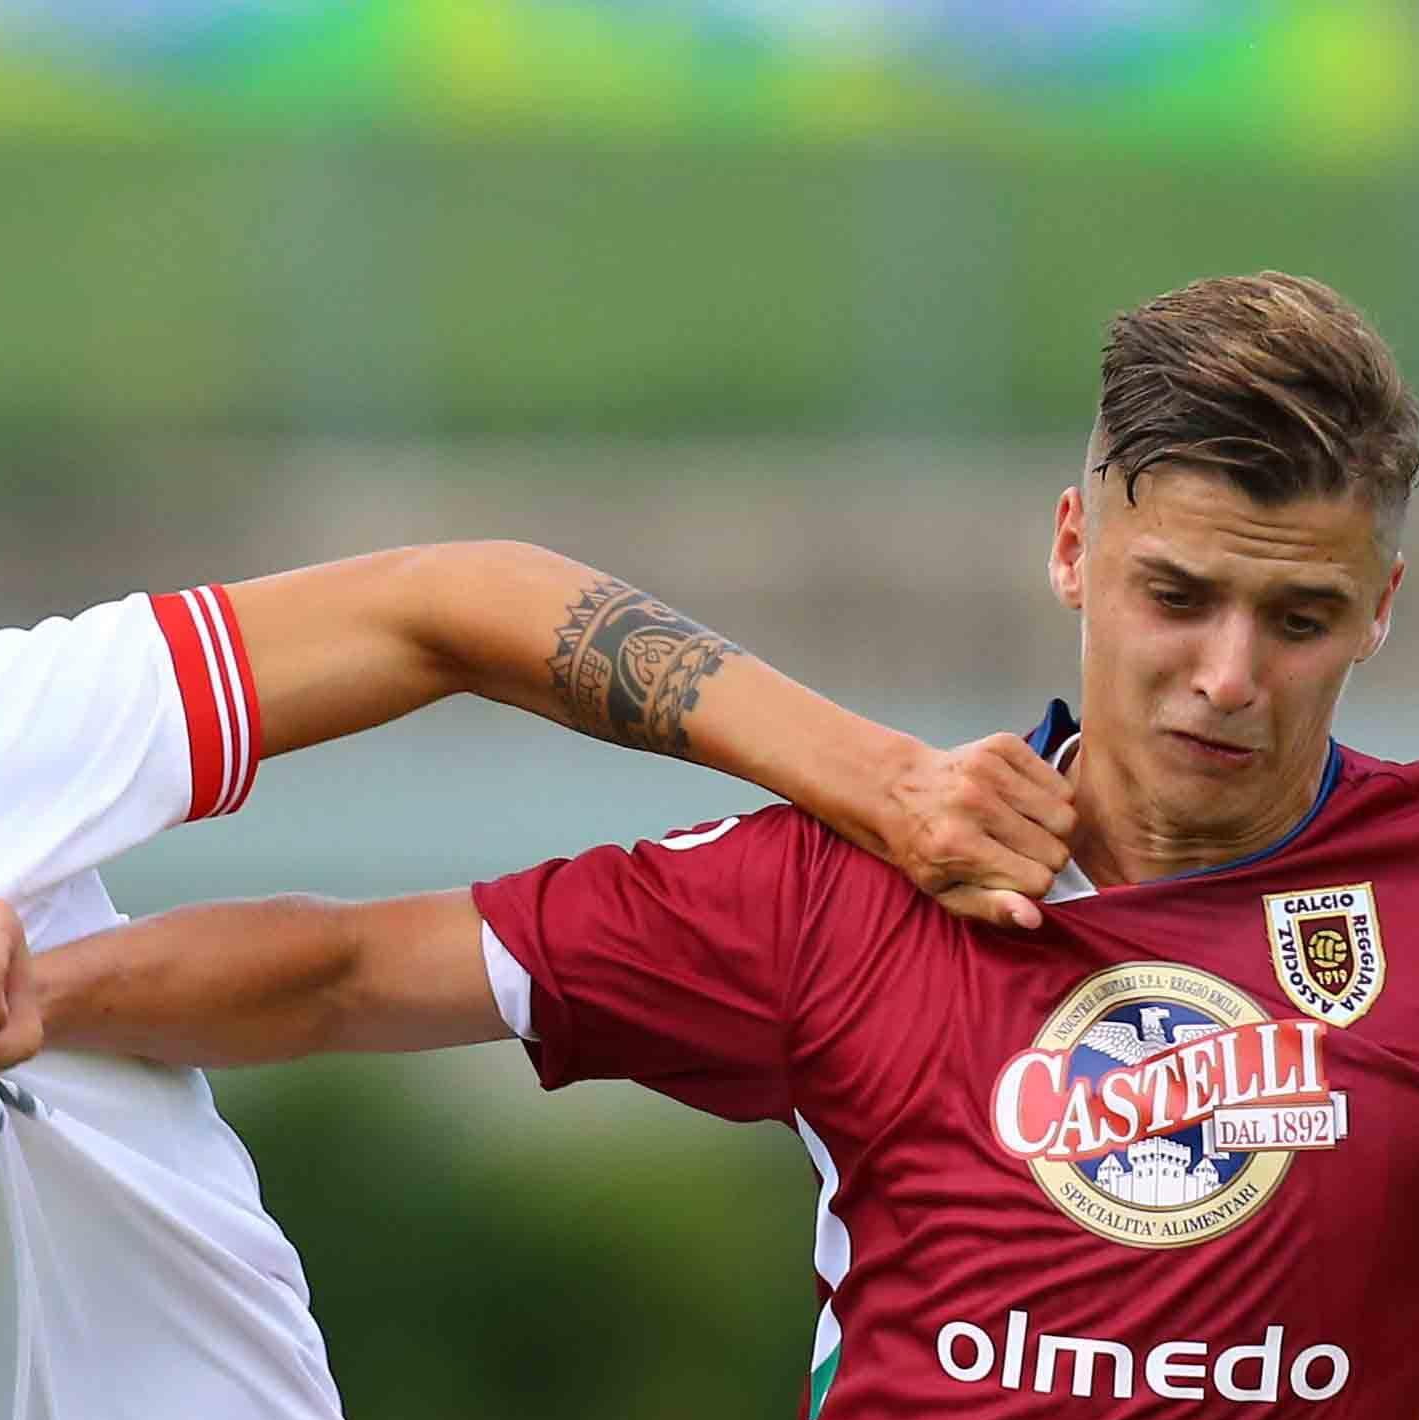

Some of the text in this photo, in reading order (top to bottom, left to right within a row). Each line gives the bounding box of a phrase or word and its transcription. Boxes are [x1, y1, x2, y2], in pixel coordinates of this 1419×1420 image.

[1284, 893, 1355, 914] CALCIO
[1315, 969, 1348, 985] 1919
[1339, 914, 1375, 1012] REGGIANA
[995, 1022, 1324, 1155] CASTELLI
[1220, 1110, 1329, 1145] DAL 1892
[1059, 1182, 1260, 1237] SPECIALITA' ALIMENTARI
[936, 1310, 1350, 1403] olmedo
